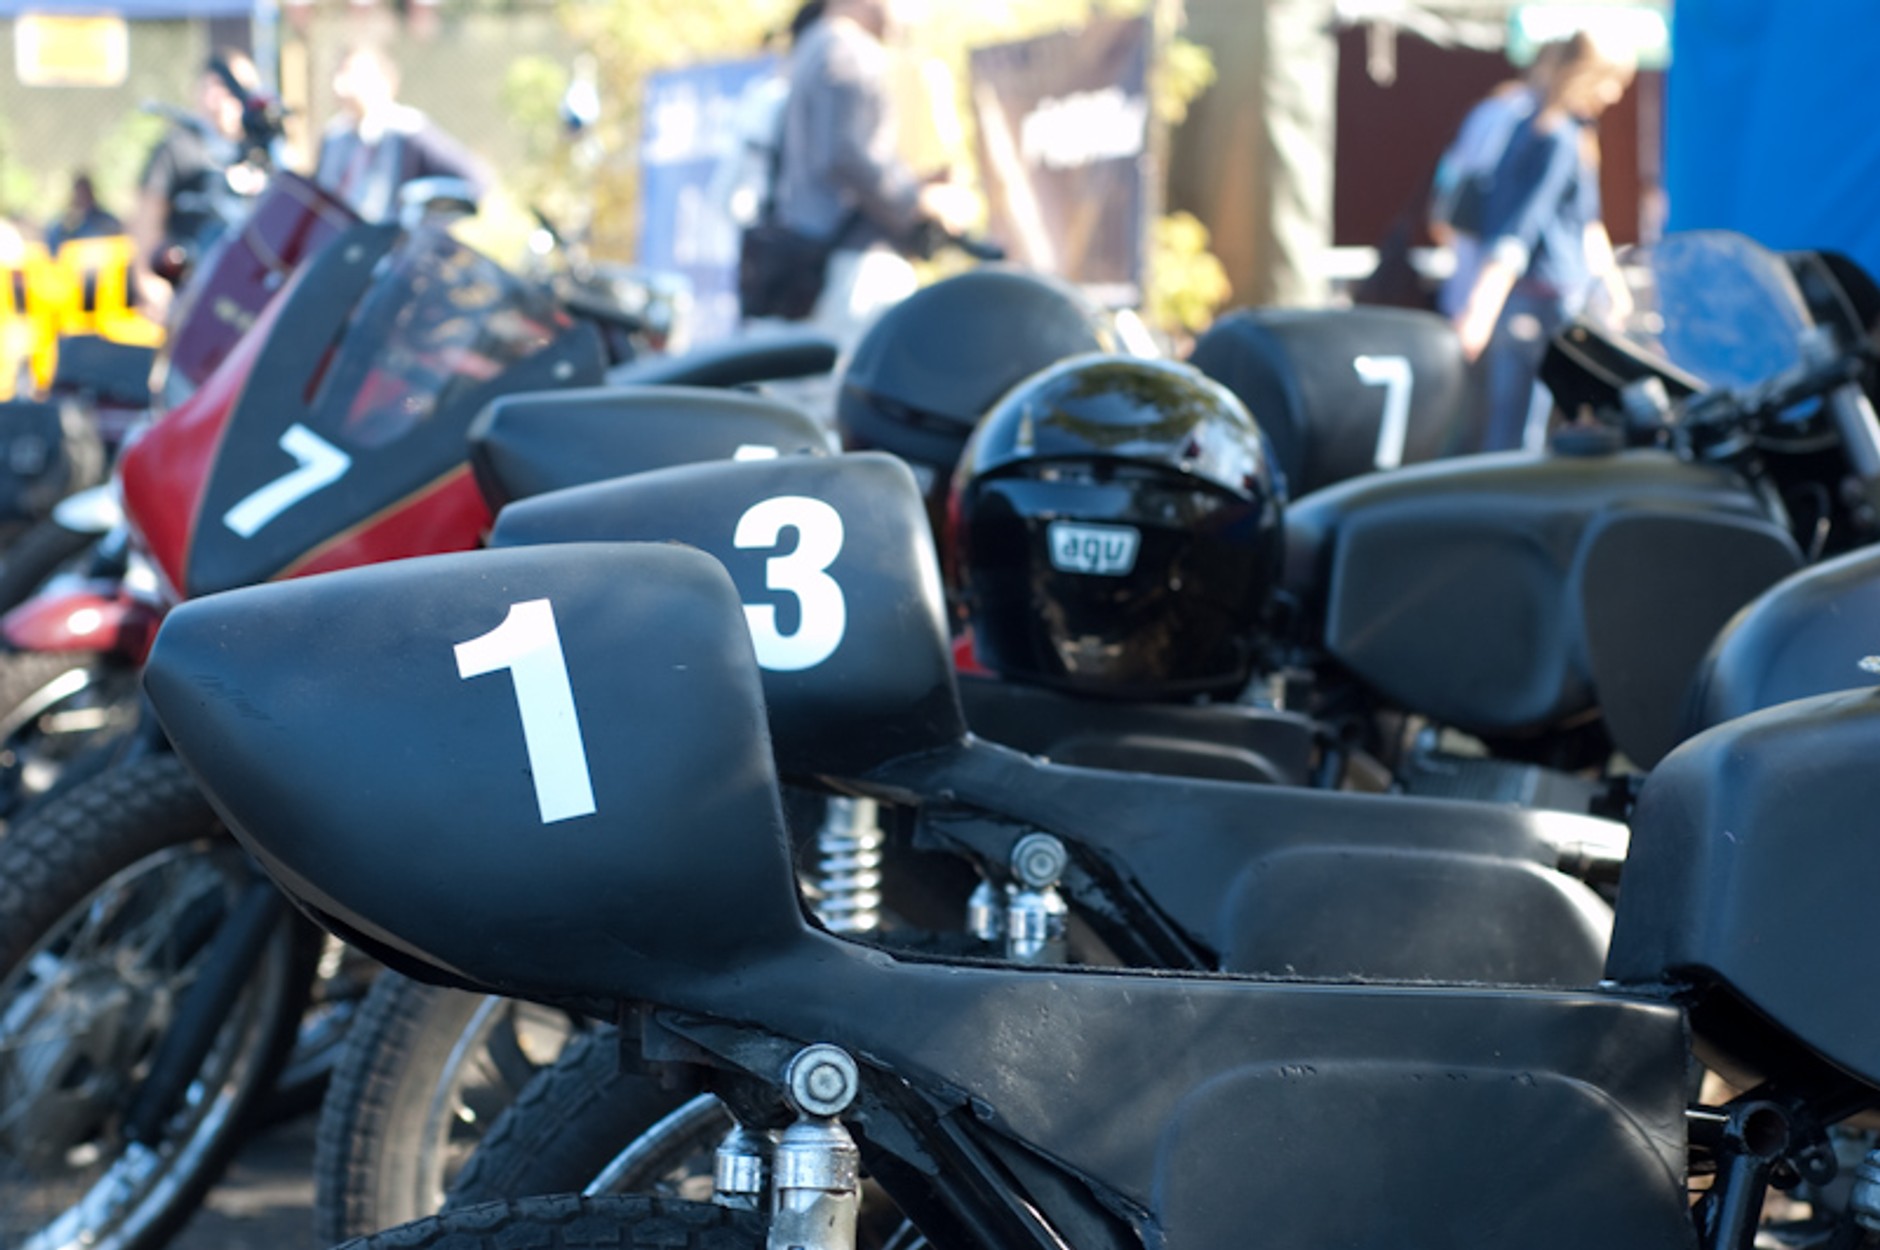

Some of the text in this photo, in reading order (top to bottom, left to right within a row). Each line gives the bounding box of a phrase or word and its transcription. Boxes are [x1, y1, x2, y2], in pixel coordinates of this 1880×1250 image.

[223, 423, 352, 538] 7
[1353, 354, 1414, 470] 7
[733, 495, 847, 671] 3
[453, 598, 596, 824] 1
